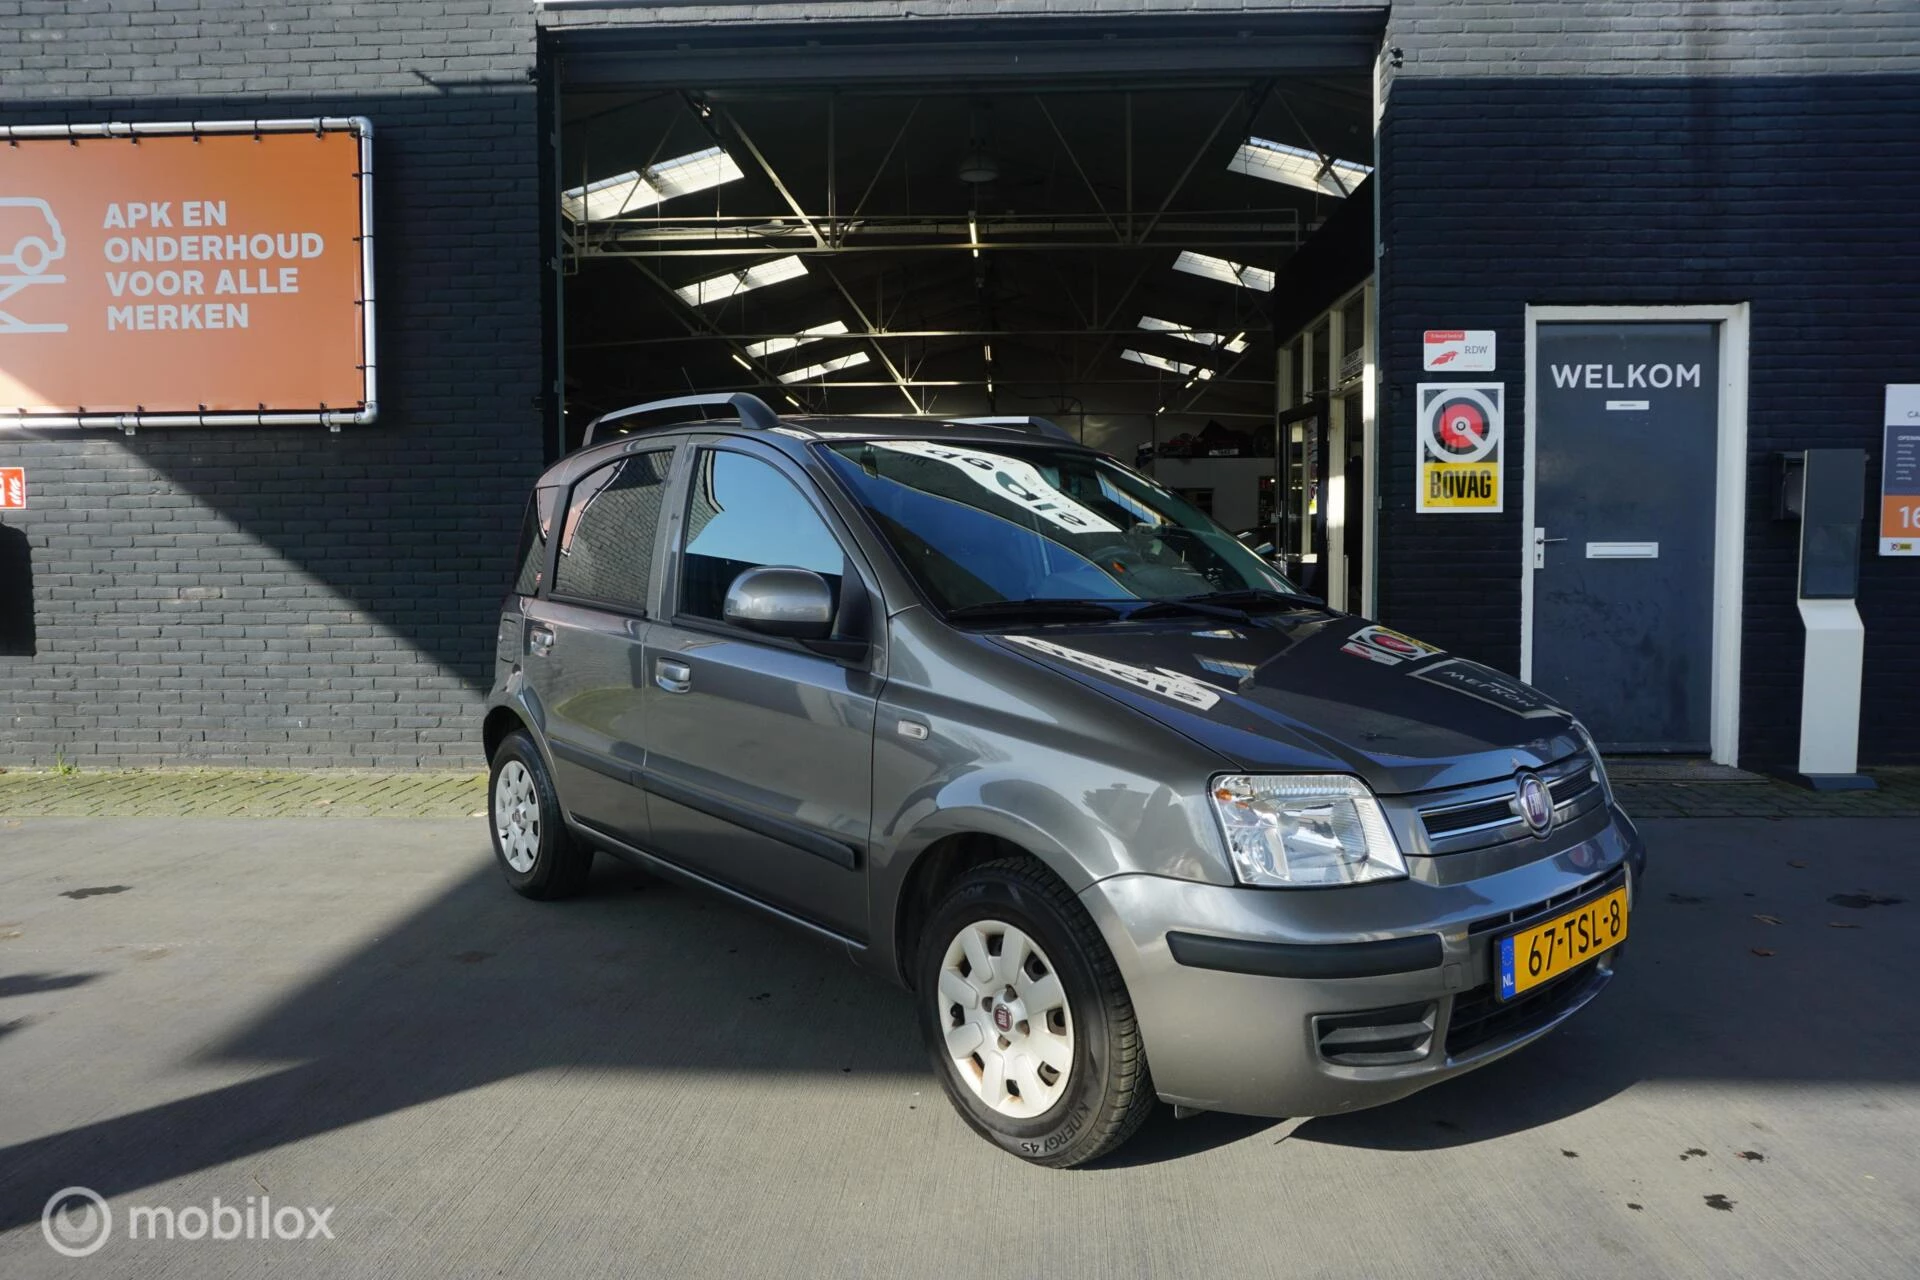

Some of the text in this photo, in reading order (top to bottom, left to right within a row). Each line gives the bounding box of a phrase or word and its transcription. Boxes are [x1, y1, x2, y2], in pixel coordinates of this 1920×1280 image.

[103, 200, 227, 229] APK EN
[103, 232, 325, 263] ONDERHOUD
[105, 267, 299, 297] VOOR ALLE
[107, 303, 249, 331] MERKEN
[1464, 345, 1488, 354] RDW
[1551, 363, 1701, 389] WELKOM
[1430, 470, 1492, 499] BOVAG
[1528, 899, 1621, 977] 67-TSL-8
[1502, 975, 1514, 988] NL
